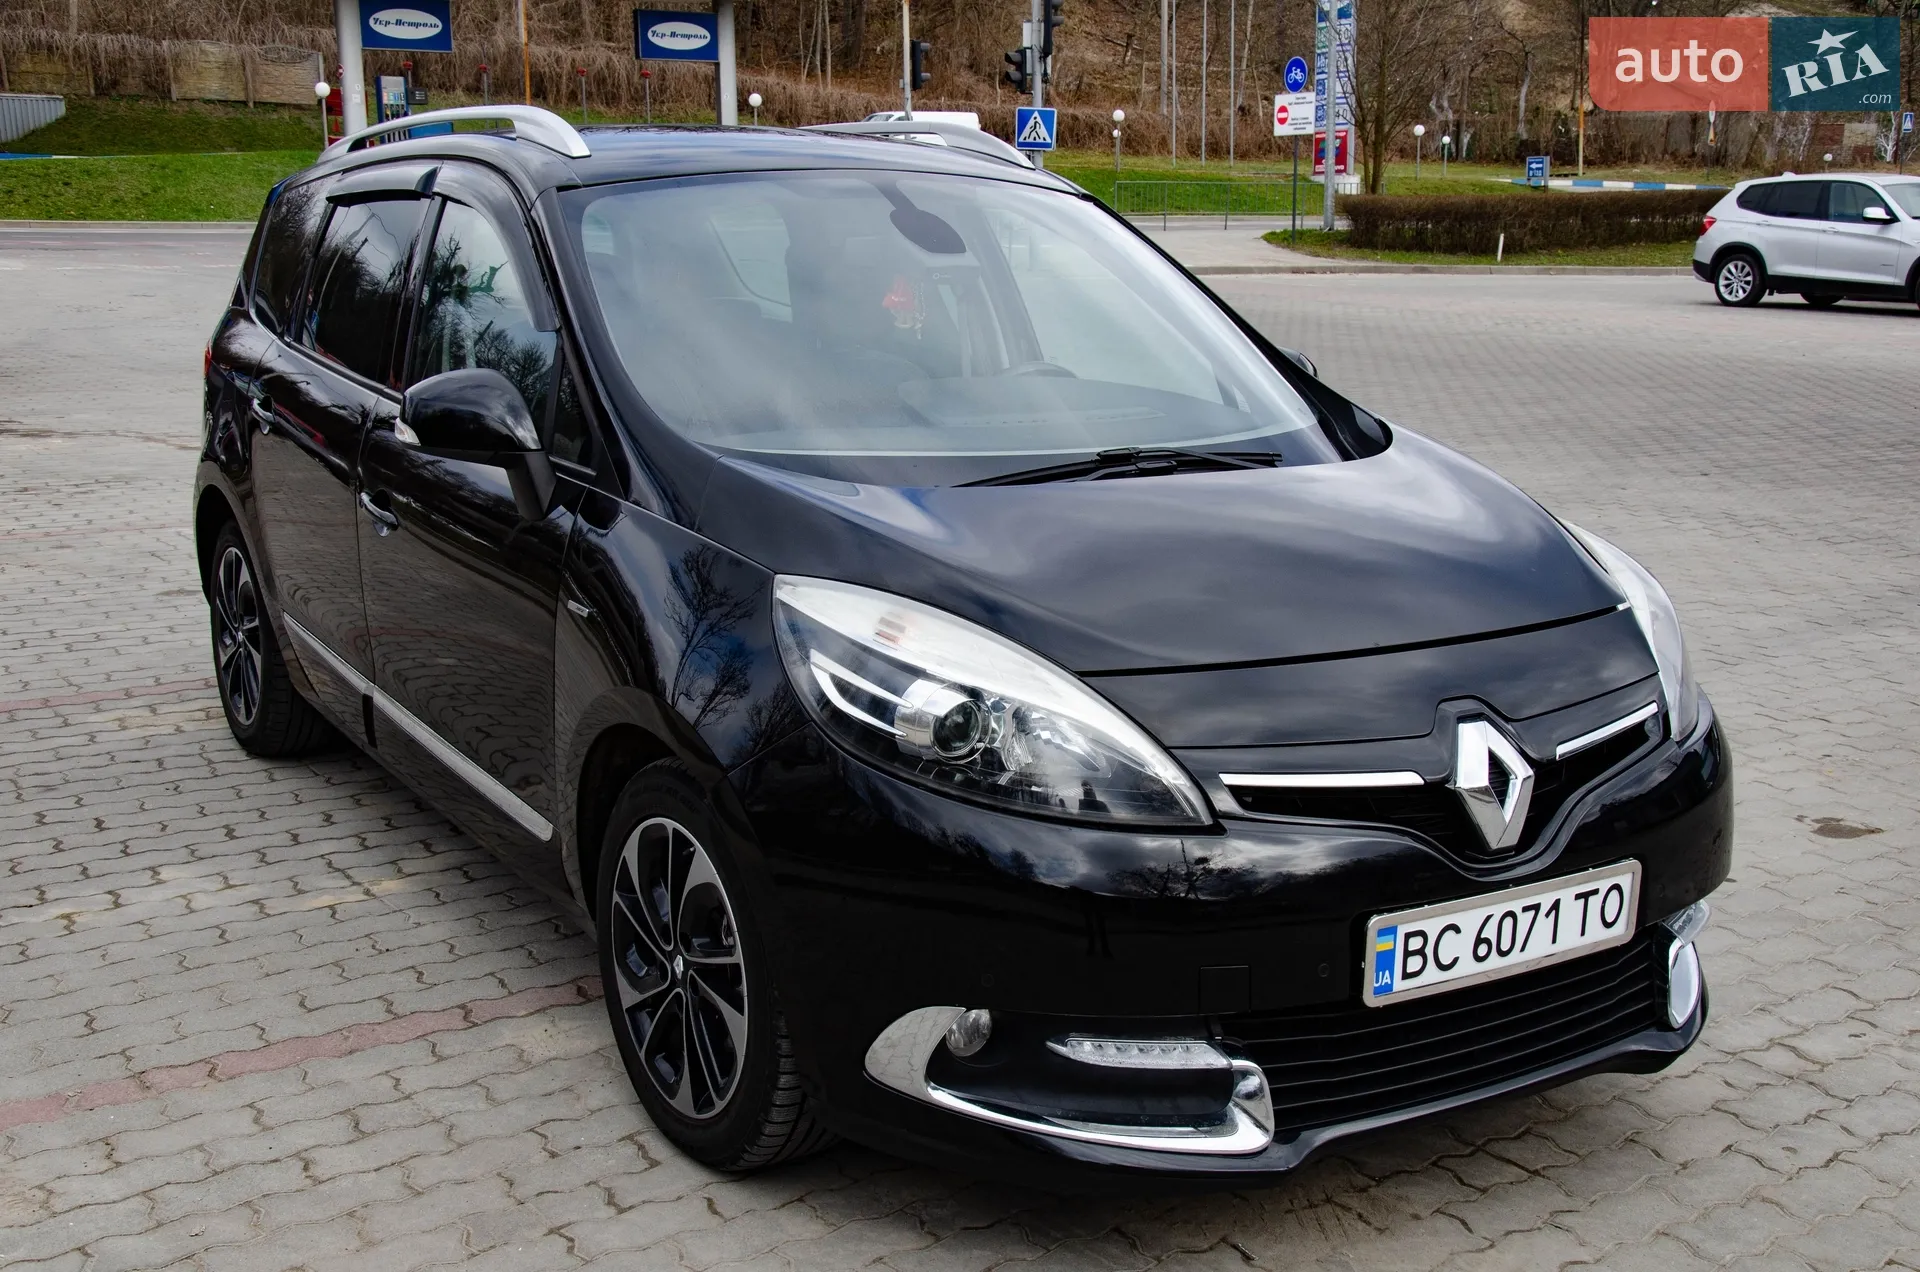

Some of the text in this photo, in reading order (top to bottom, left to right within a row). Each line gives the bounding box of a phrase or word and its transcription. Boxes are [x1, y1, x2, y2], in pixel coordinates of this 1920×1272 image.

[1401, 883, 1625, 981] BC 6071 TO
[1373, 971, 1392, 987] UA
